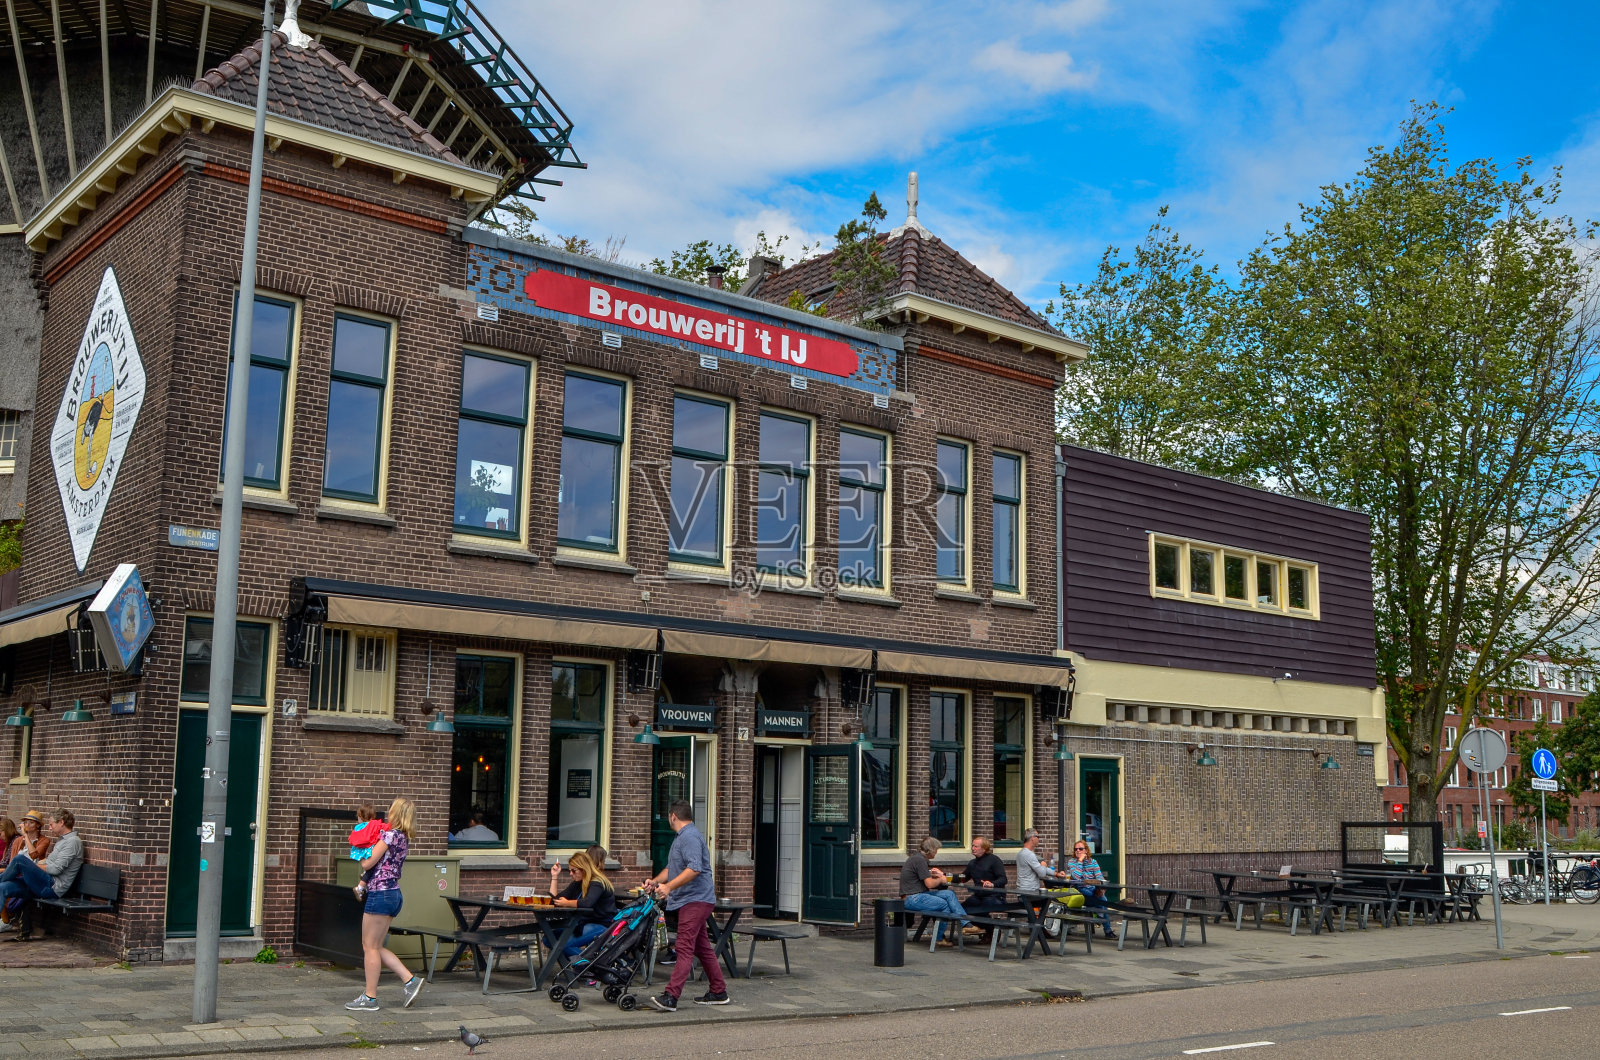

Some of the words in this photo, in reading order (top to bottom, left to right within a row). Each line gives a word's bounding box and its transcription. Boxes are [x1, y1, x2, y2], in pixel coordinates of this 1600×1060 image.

[589, 286, 745, 354] Brouwerij
[755, 328, 771, 355] 't
[781, 335, 807, 364] IJ
[65, 454, 116, 518] AMSTERDAM
[172, 527, 217, 541] FUNENKADE
[187, 539, 214, 547] CENTRUM
[661, 708, 712, 722] VROUWEN
[764, 715, 803, 727] MANNEN
